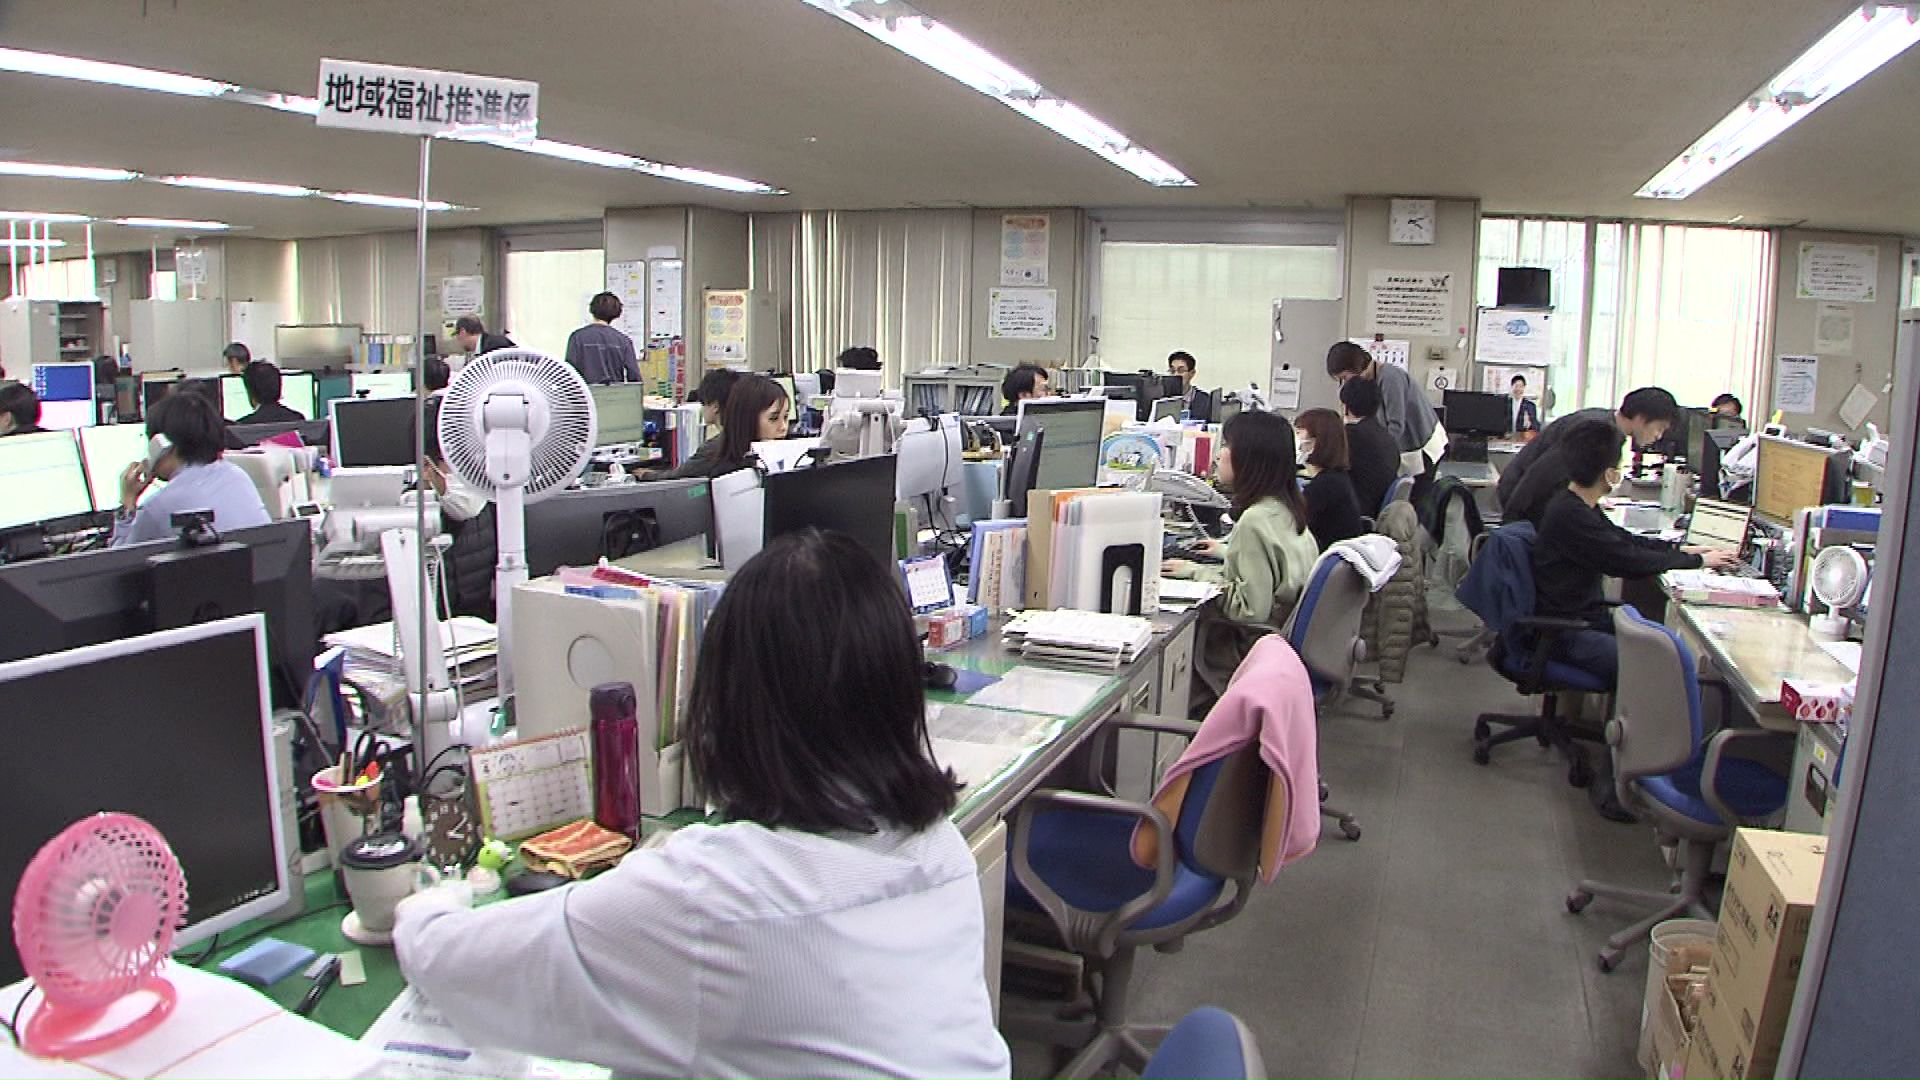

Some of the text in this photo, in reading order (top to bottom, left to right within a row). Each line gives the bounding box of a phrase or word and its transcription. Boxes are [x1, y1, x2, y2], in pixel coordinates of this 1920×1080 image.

[324, 72, 532, 125] 地域福祉推進係
